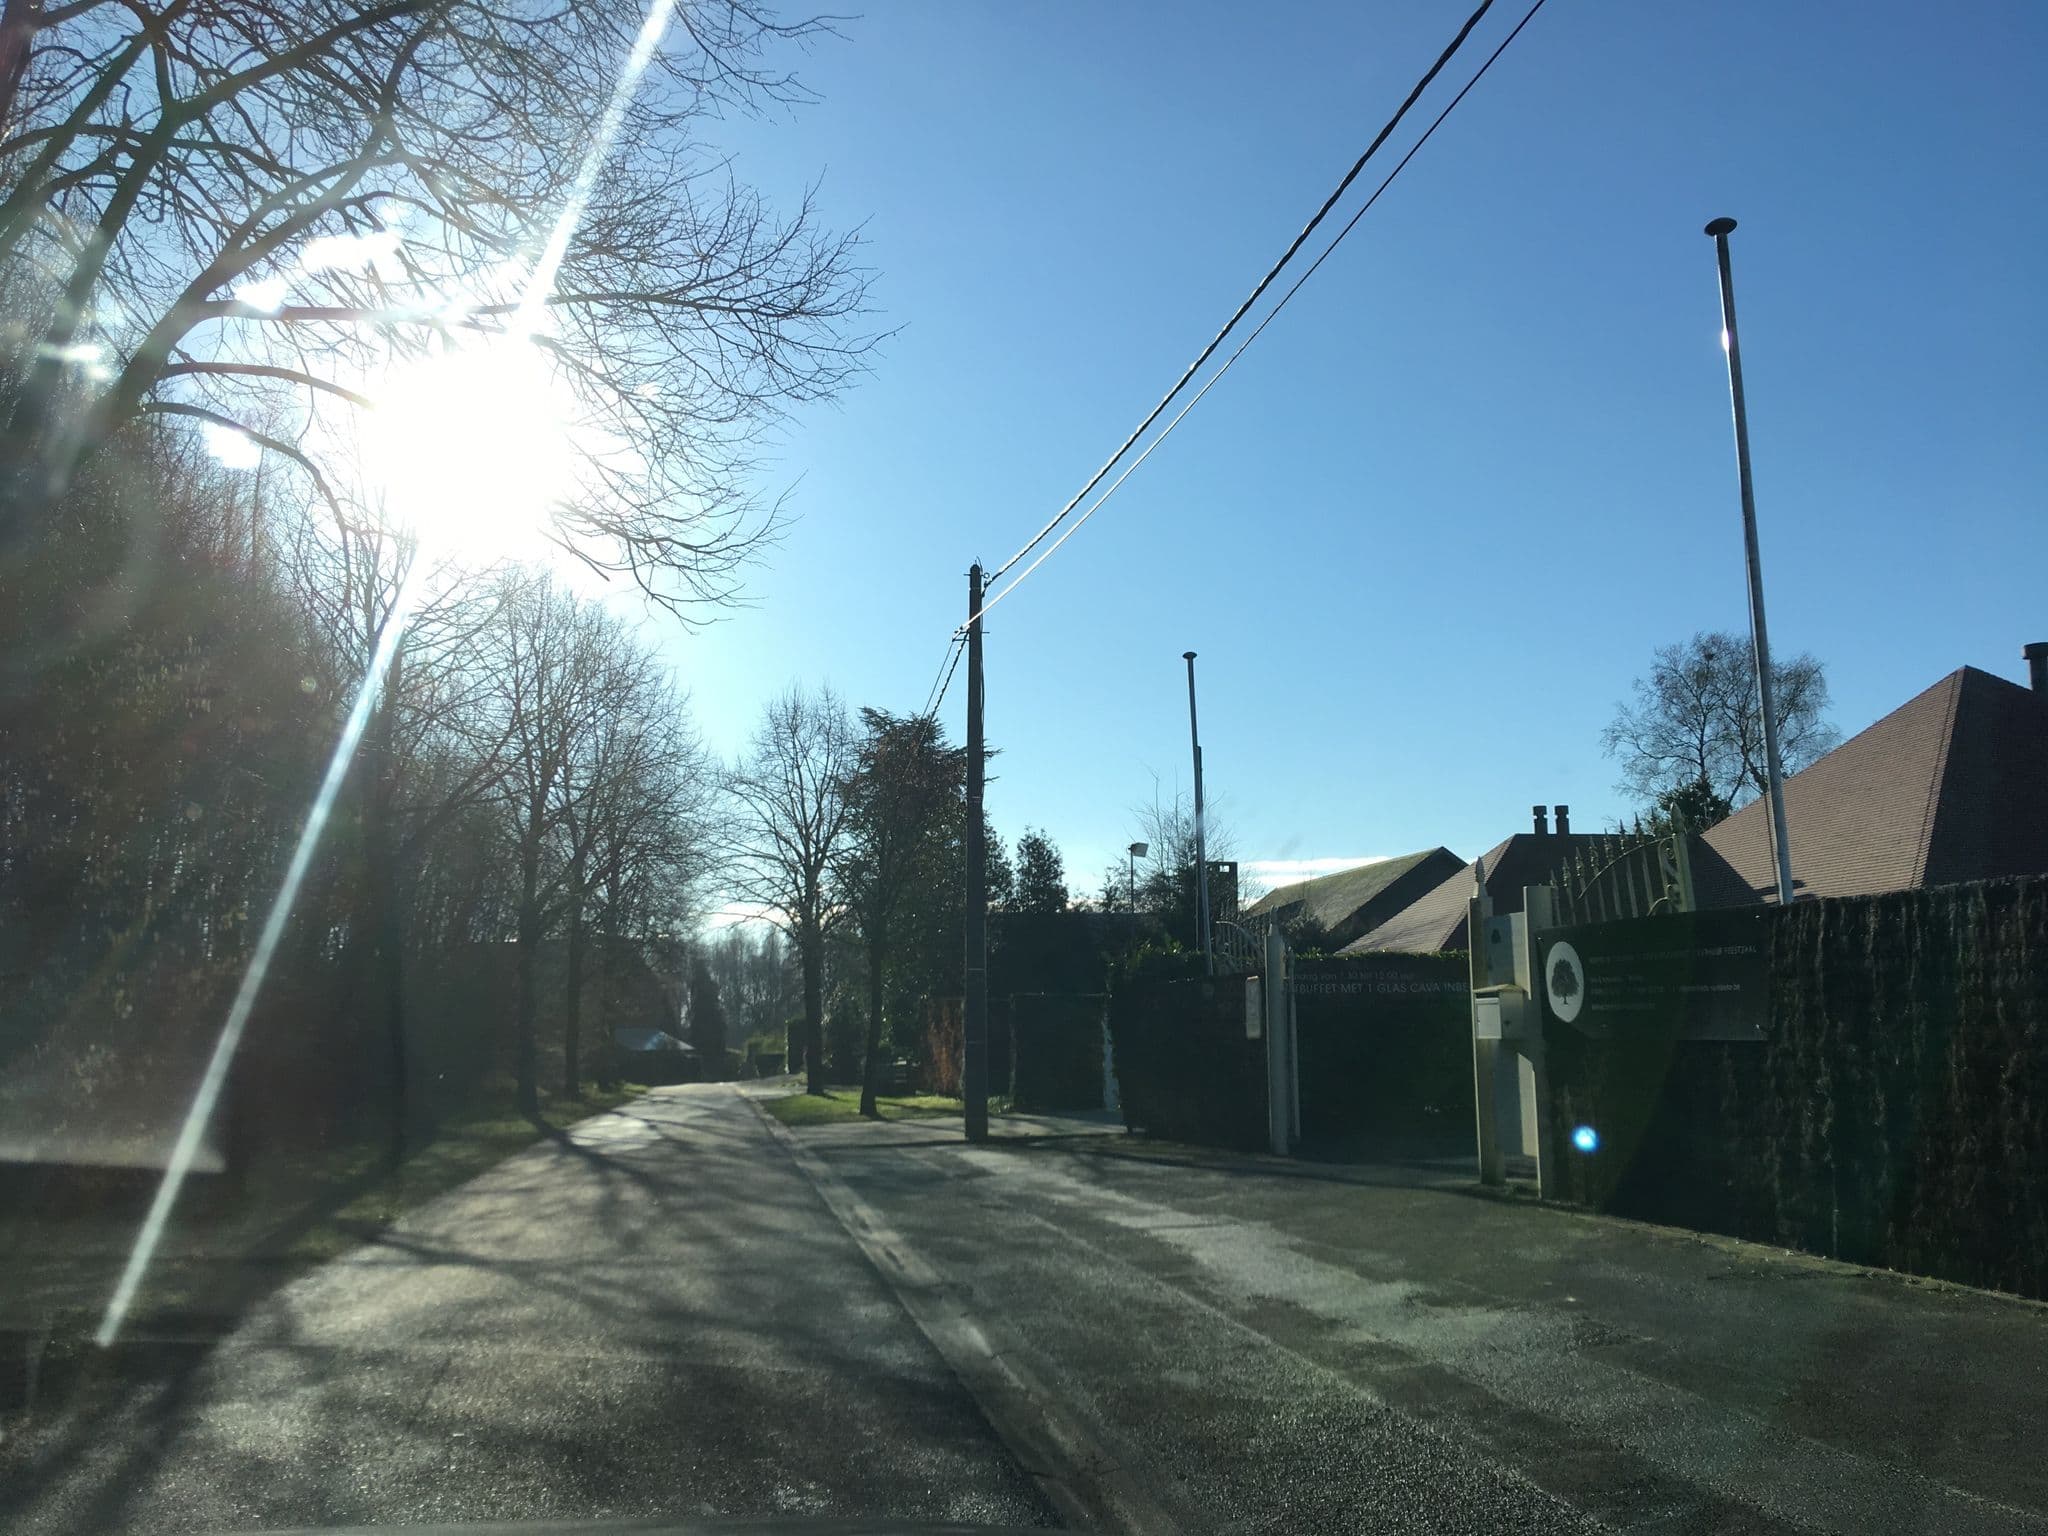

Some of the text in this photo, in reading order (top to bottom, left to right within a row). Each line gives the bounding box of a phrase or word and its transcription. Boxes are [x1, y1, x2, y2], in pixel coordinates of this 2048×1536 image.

[1340, 983, 1362, 993] MET
[1376, 982, 1408, 993] GLAS
[1410, 982, 1441, 993] CAVA
